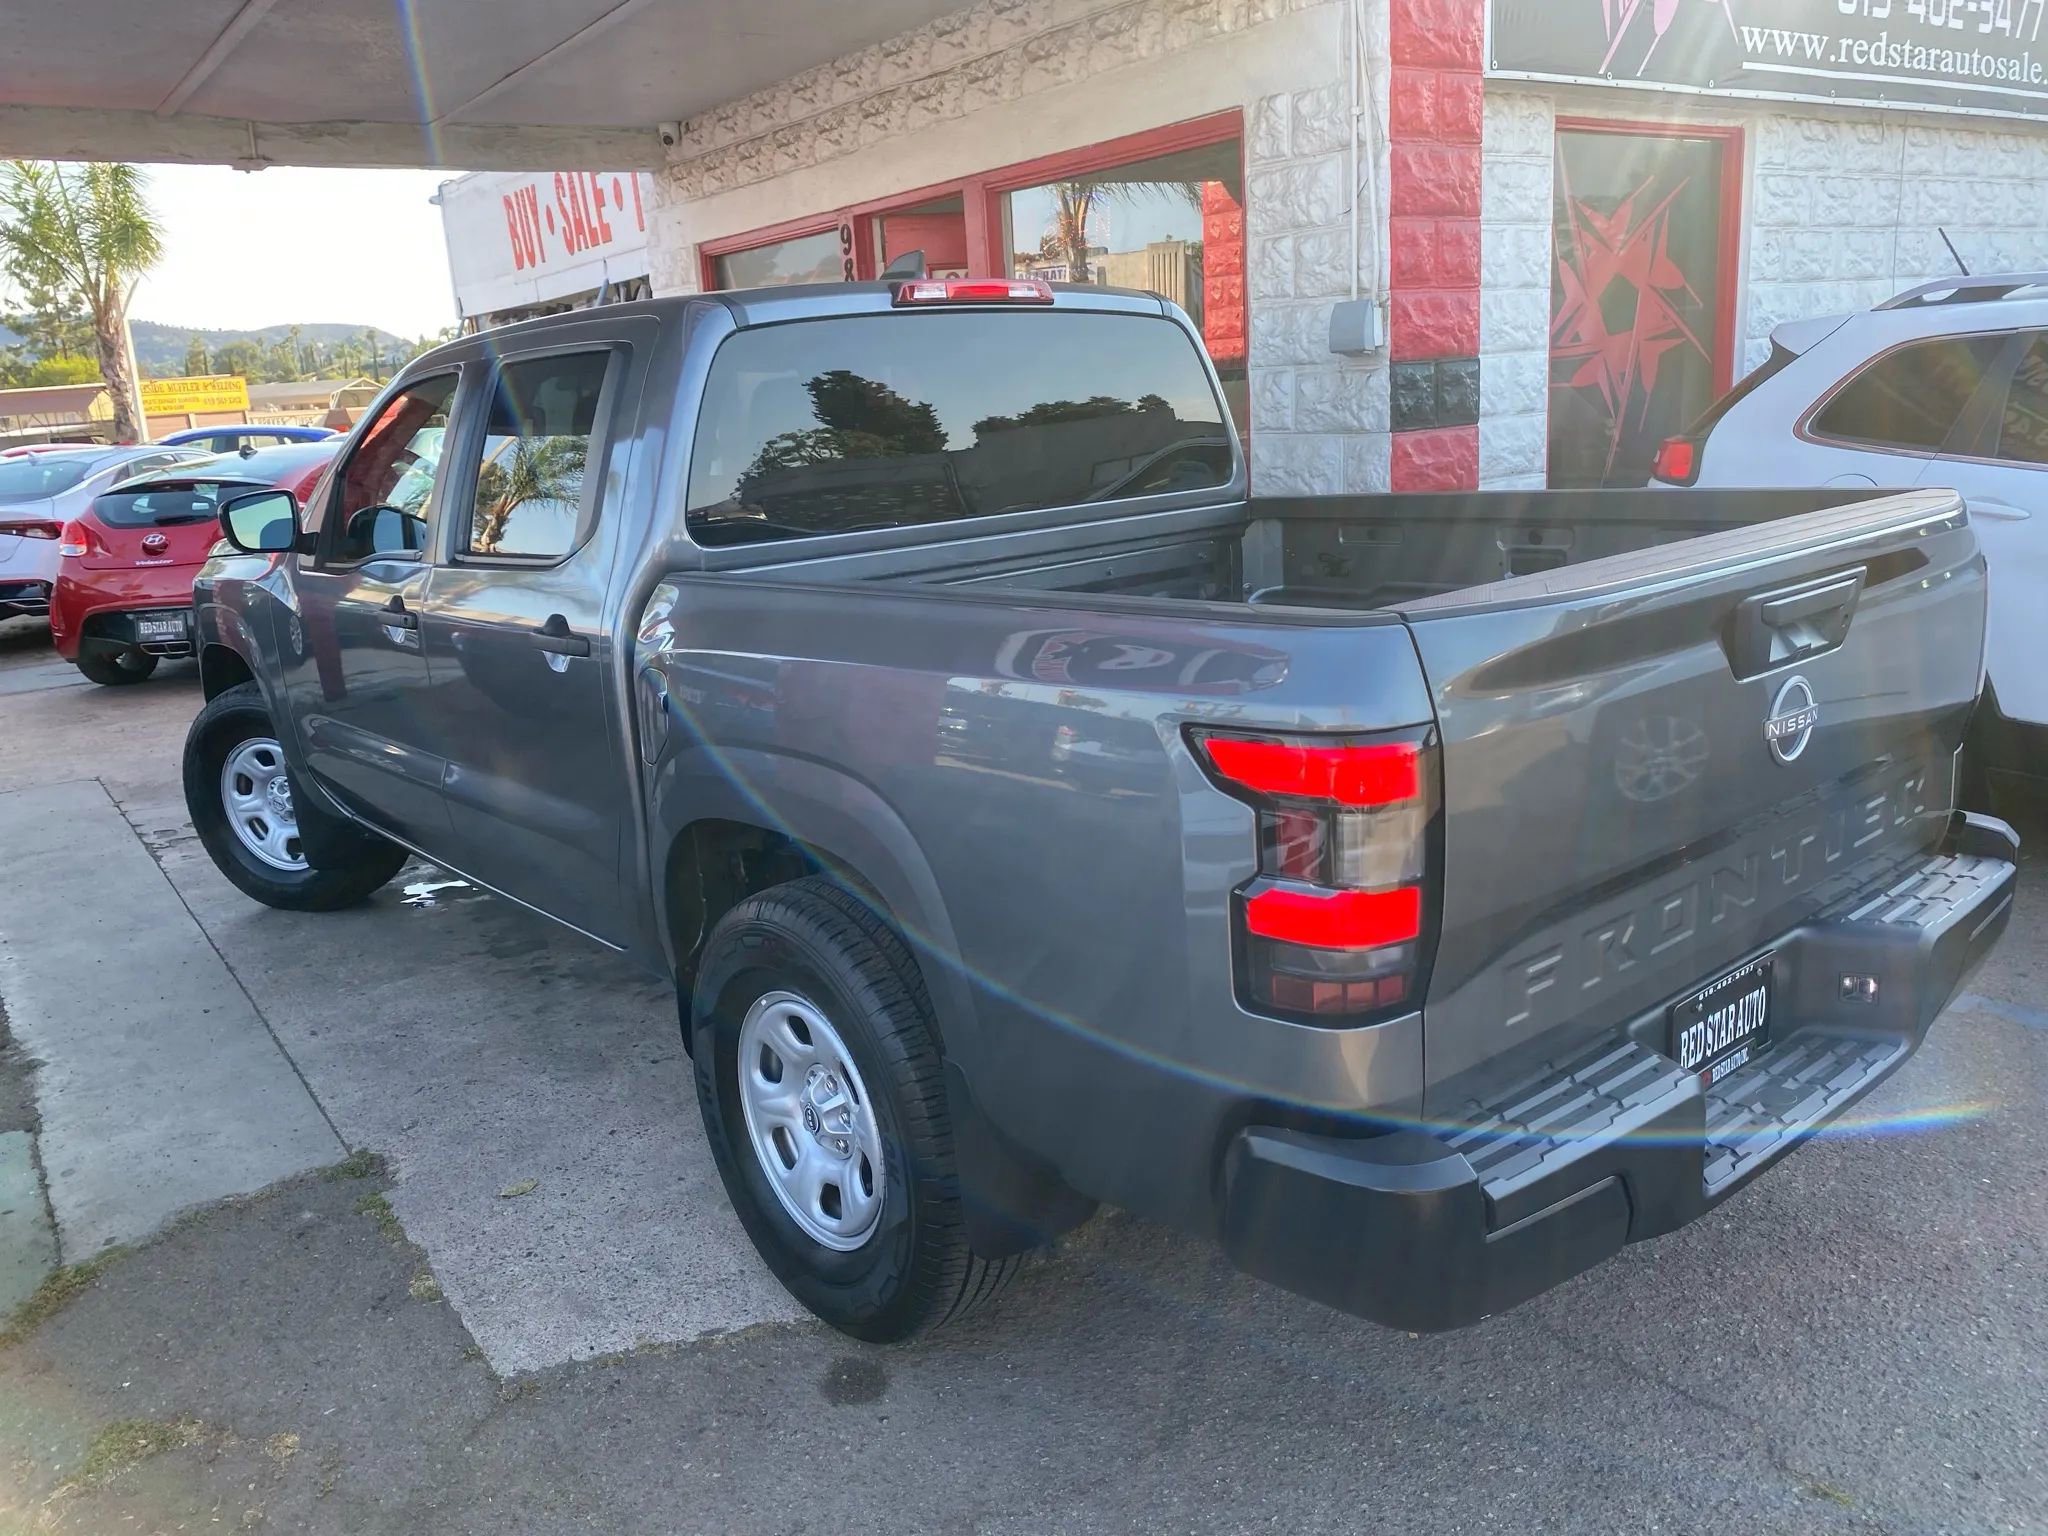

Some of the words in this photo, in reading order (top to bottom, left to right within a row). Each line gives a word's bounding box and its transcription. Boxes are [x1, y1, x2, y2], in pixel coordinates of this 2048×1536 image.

[503, 183, 546, 271] BUY
[554, 170, 612, 256] SALE
[140, 622, 152, 634] RED
[167, 620, 182, 632] AUTO
[1768, 707, 1818, 737] NISSAN
[1503, 772, 1928, 1028] FRONTIER
[1680, 1021, 1705, 1070] RED
[1705, 1003, 1736, 1058] STAR
[1735, 985, 1766, 1039] AUTO
